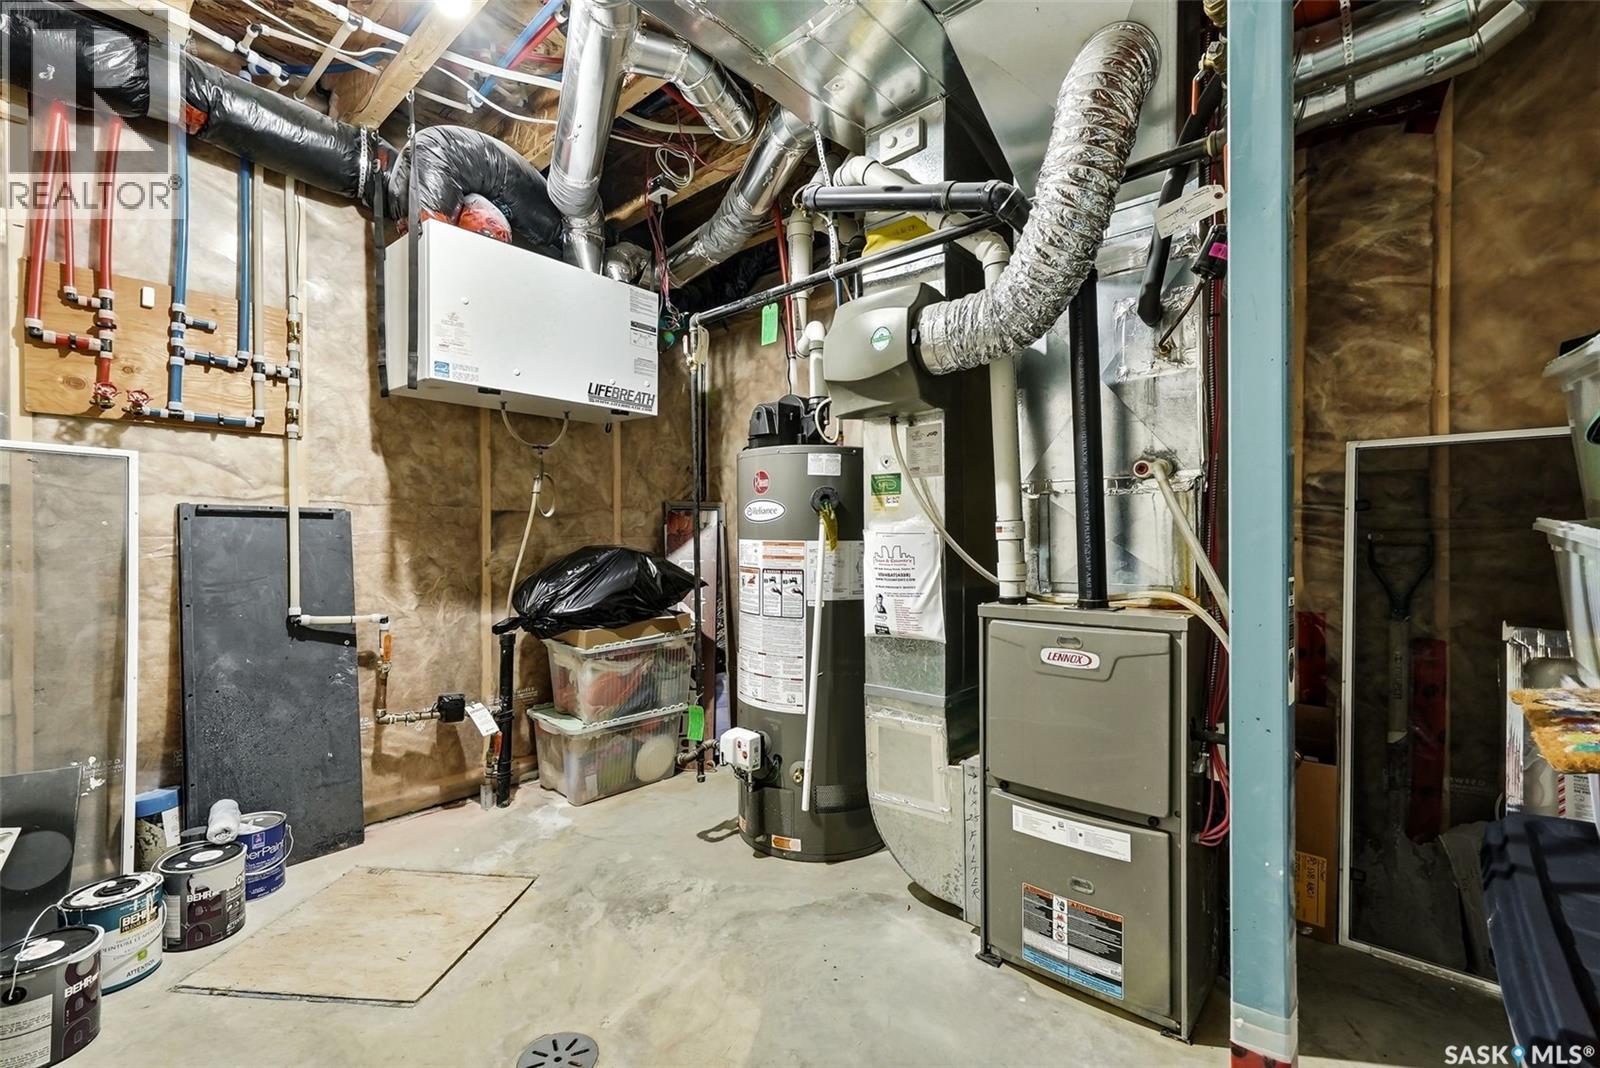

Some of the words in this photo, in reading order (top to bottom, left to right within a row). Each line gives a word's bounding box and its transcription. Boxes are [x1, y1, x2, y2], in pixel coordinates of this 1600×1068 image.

[587, 382, 655, 408] LIFEBREATH
[1047, 652, 1083, 664] LENNOX
[187, 891, 212, 903] BEHR
[64, 975, 92, 998] BEHR
